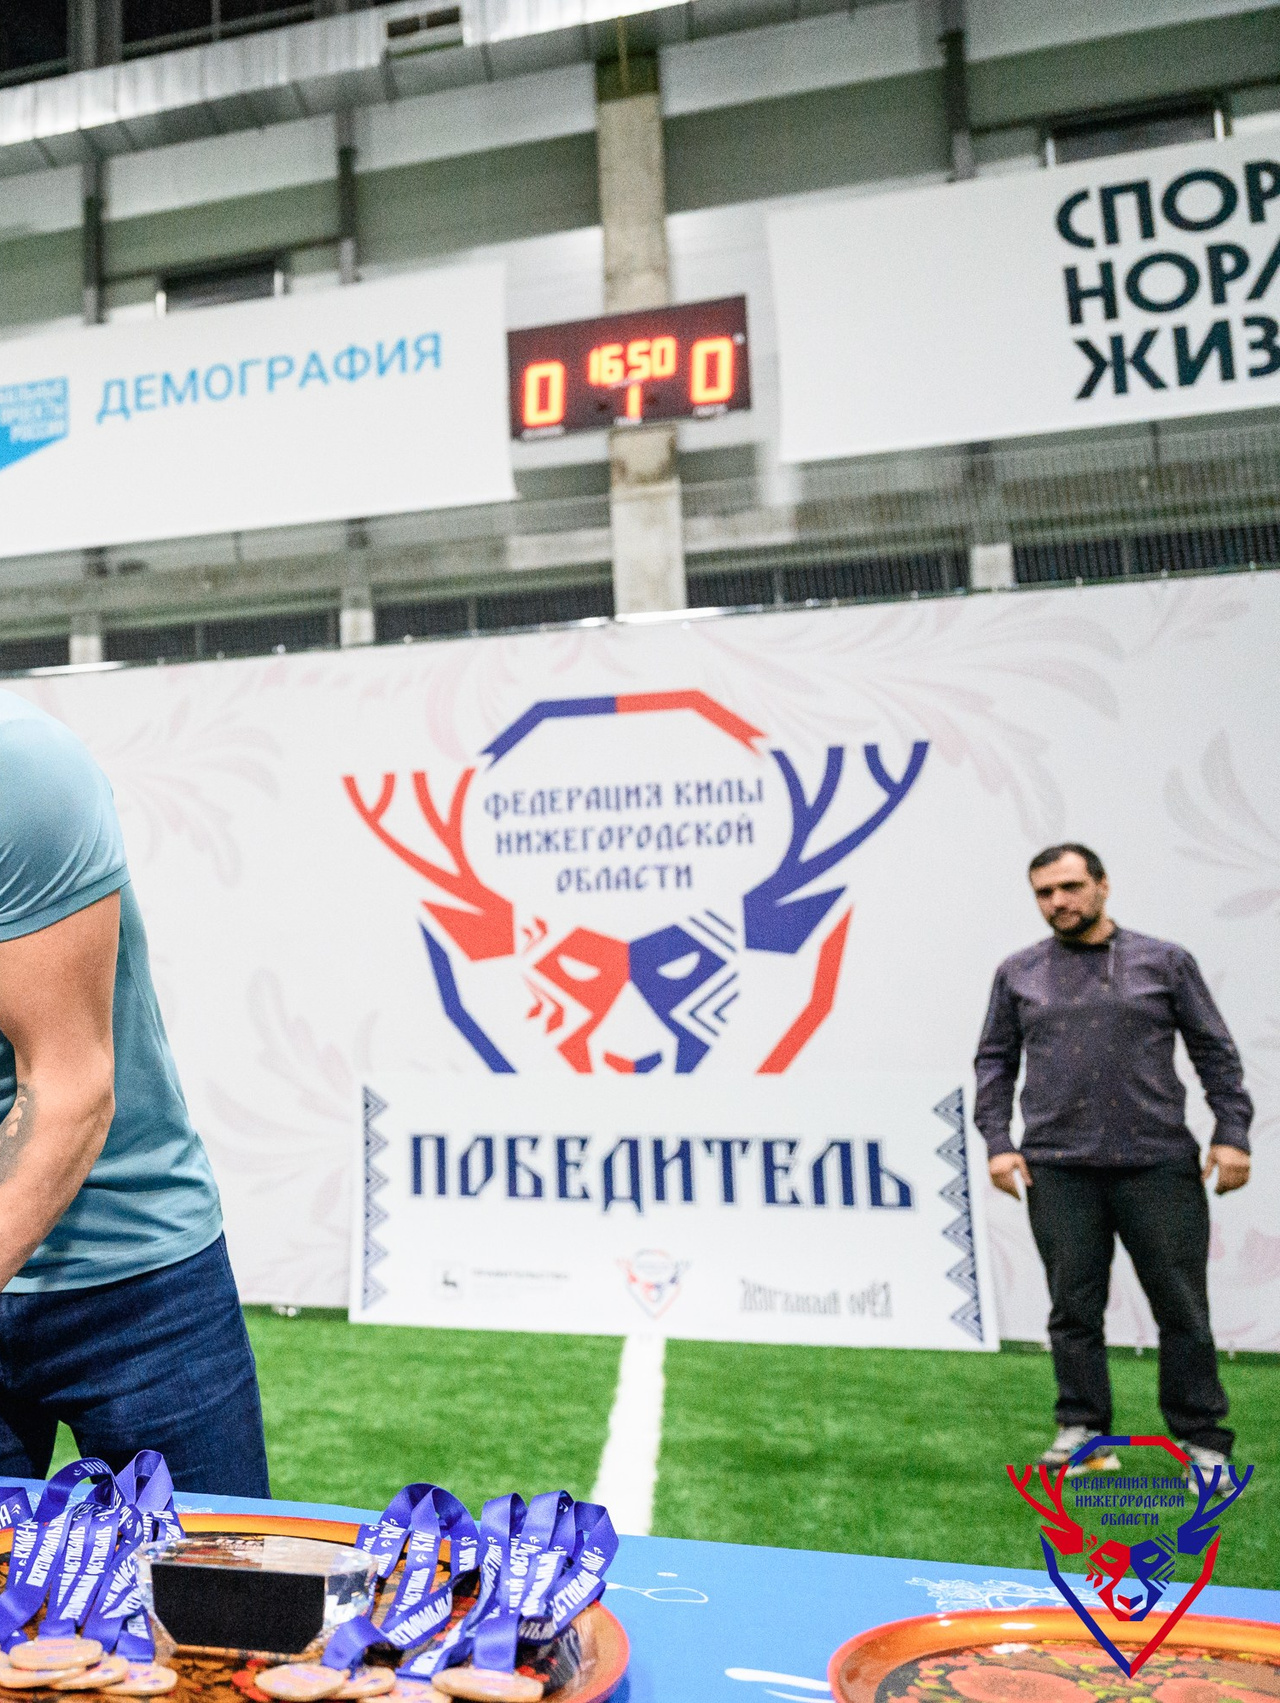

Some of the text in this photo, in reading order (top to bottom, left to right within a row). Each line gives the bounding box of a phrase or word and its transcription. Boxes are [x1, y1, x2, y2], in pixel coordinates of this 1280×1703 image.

[97, 332, 442, 424] ДЕМОГРАФИЯ
[523, 359, 566, 428] 0
[690, 335, 734, 404] 0
[483, 777, 765, 820] ФЕДЕРАЦИЯ КИЛЫ
[495, 813, 755, 856] НИЖЕГОРОДСКОЙ
[556, 864, 693, 893] ОБЛАСТИ
[410, 1133, 915, 1216] ПОБЕДИТЕЛЬ
